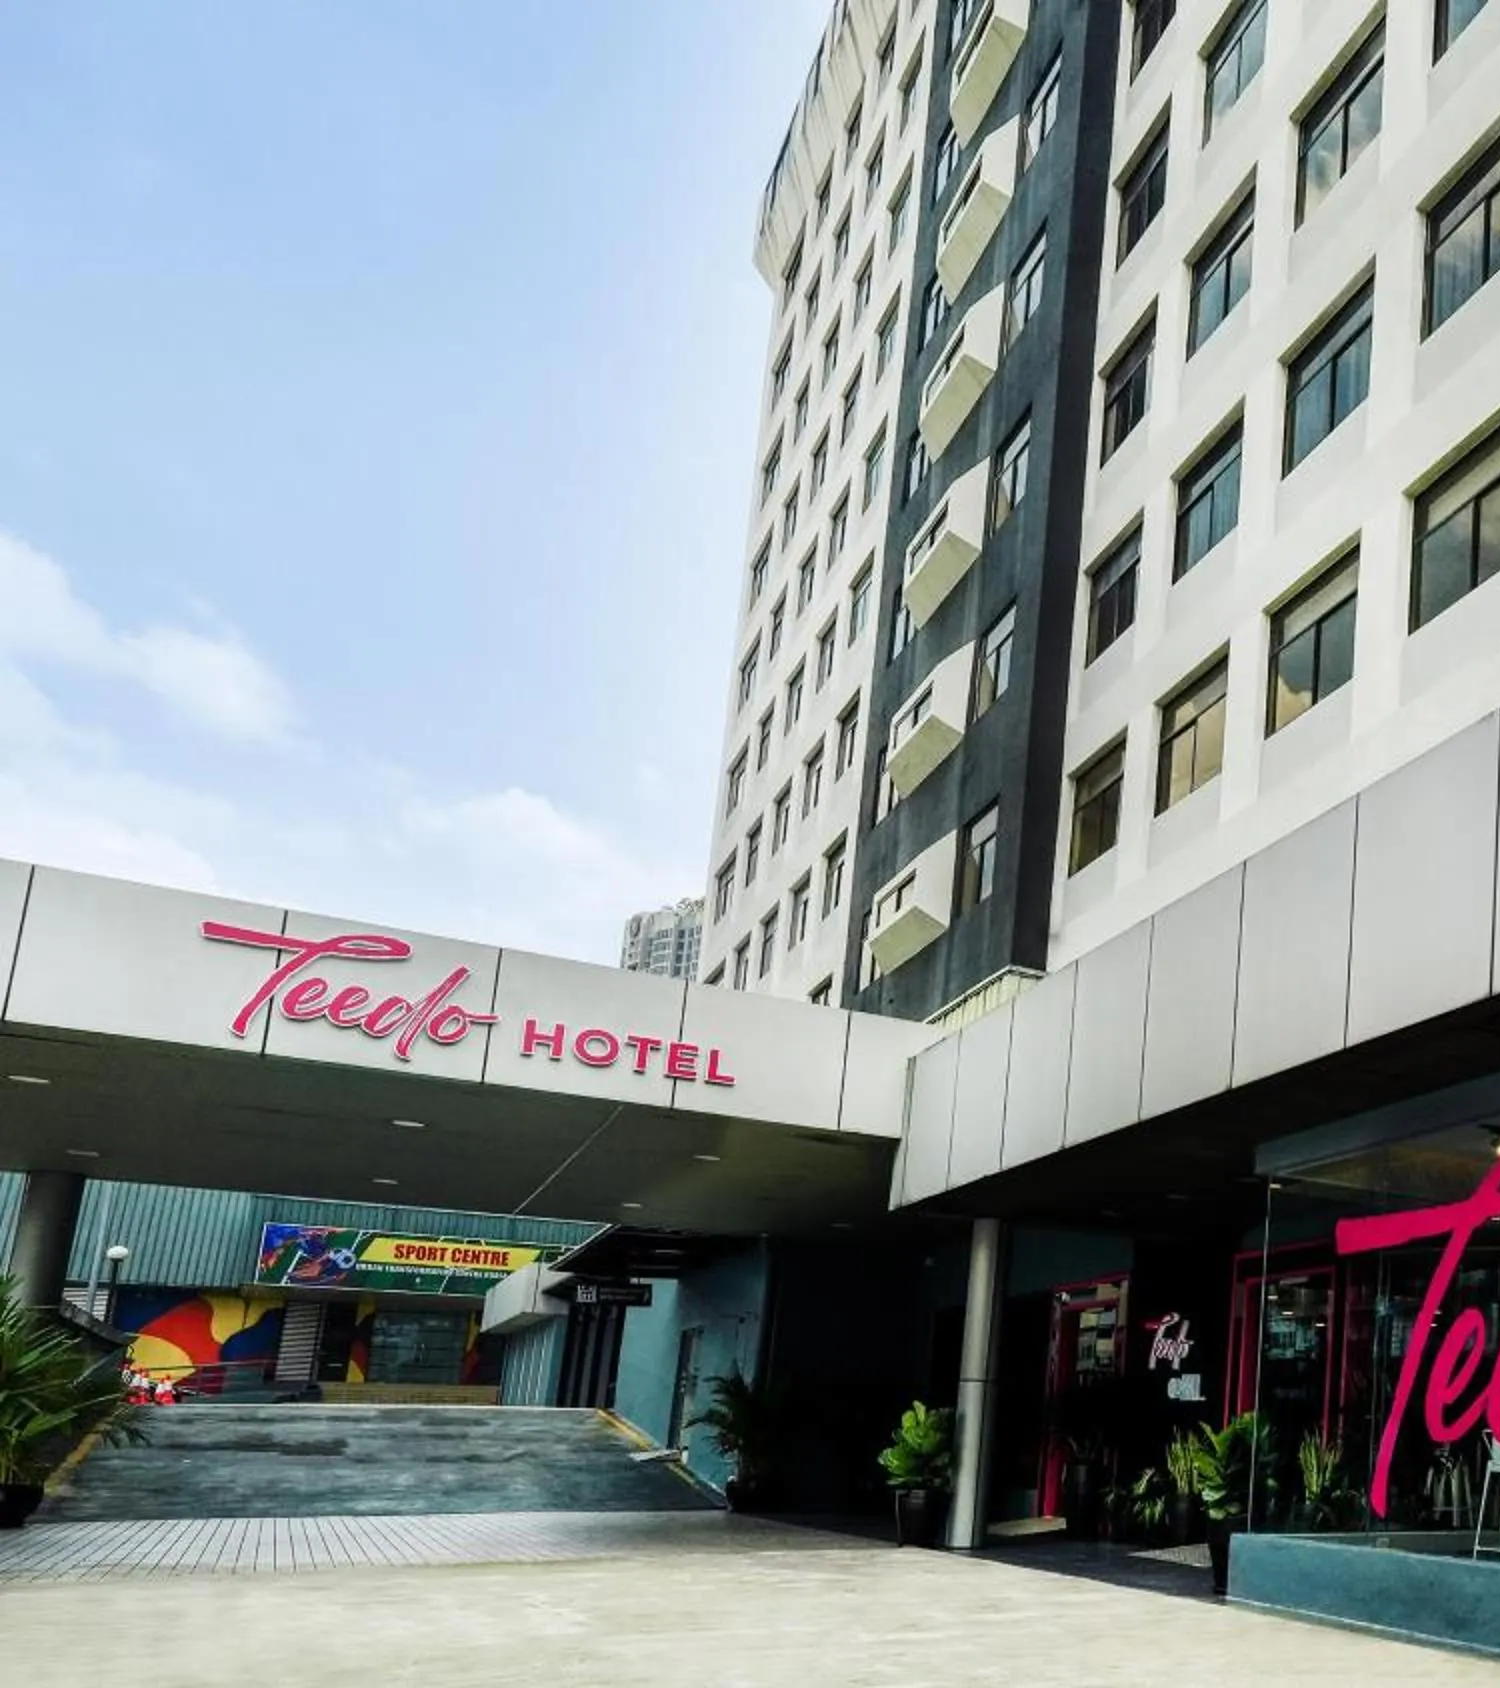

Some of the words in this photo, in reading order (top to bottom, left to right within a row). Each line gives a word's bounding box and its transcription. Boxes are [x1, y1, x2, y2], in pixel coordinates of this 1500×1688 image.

[200, 920, 500, 1063] Teedo
[520, 1017, 737, 1086] HOTEL
[393, 1243, 448, 1263] SPORT
[451, 1248, 510, 1267] CENTRE
